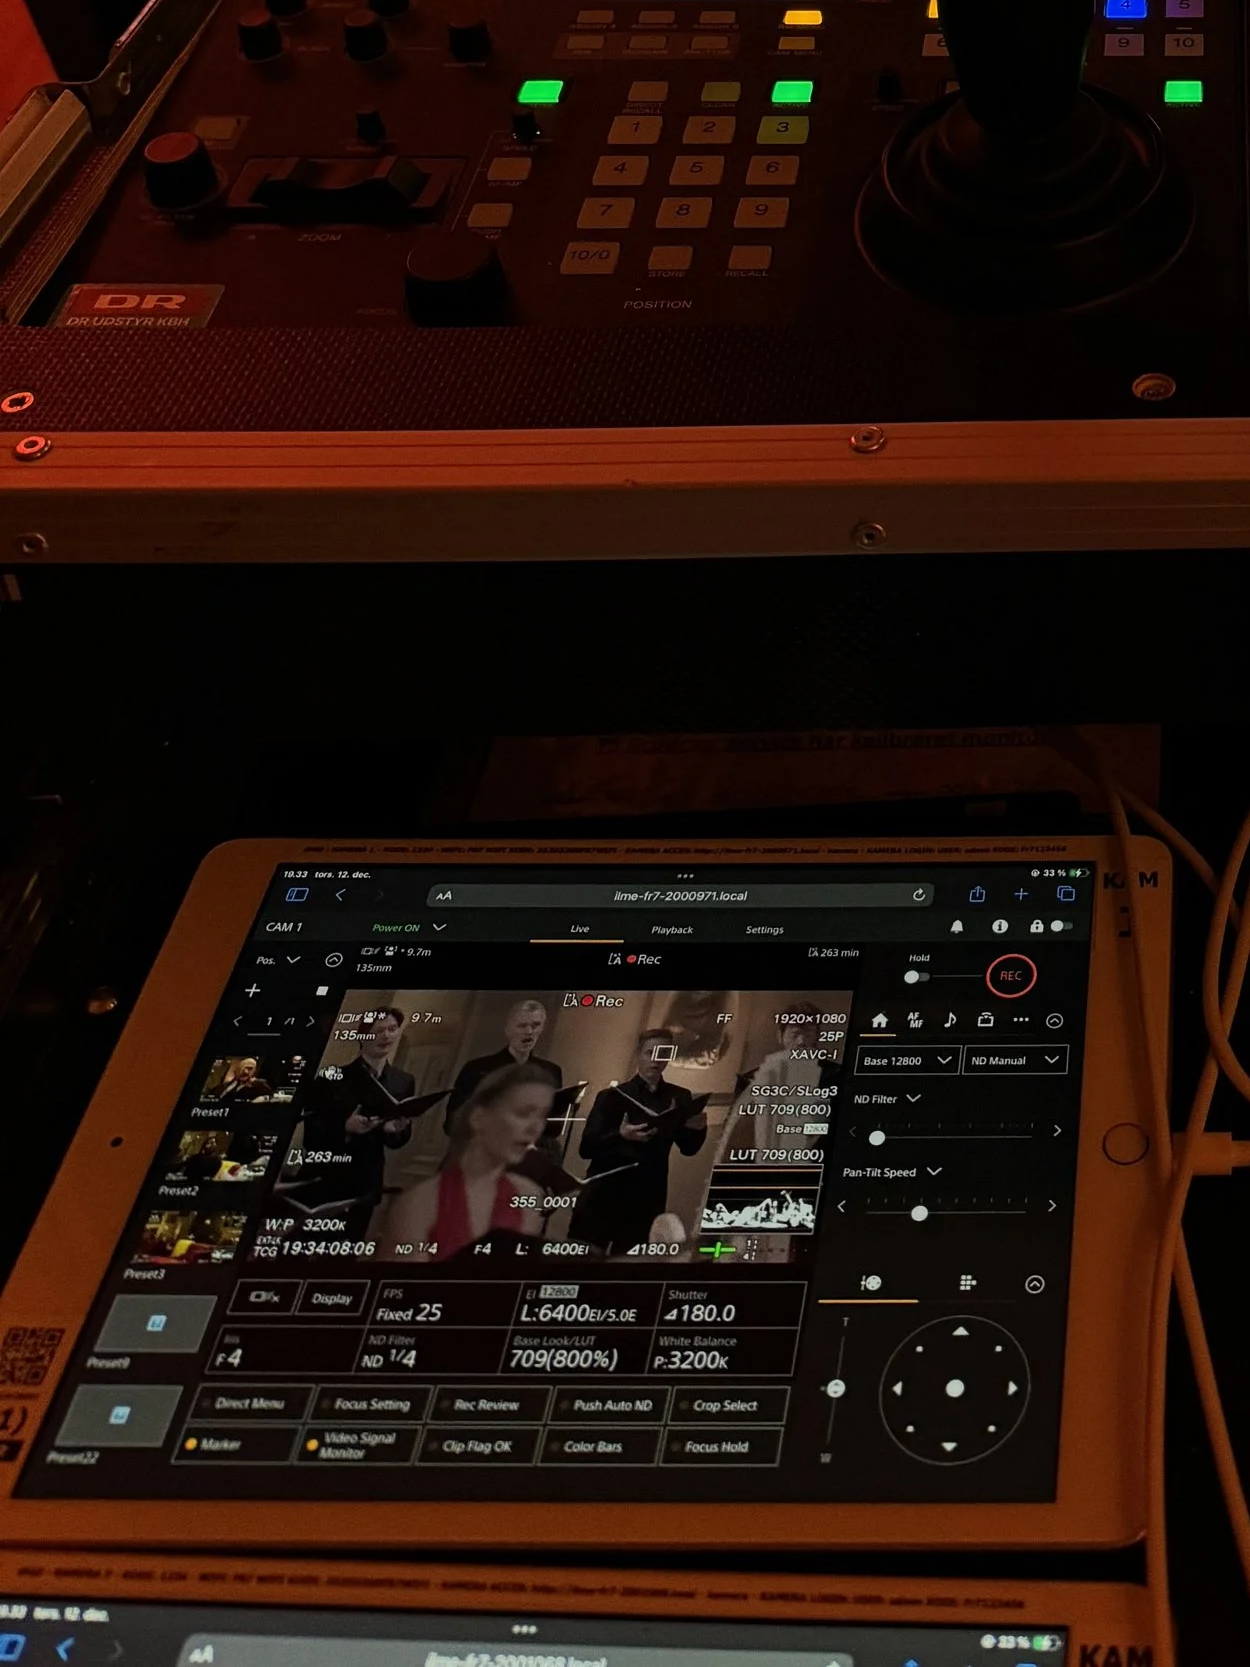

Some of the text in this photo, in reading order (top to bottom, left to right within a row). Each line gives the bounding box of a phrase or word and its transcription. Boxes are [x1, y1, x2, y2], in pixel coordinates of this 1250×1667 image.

[1120, 0, 1131, 8] 4
[1179, 0, 1190, 9] 5
[1118, 38, 1129, 47] 9
[1174, 38, 1194, 47] 10
[631, 122, 641, 133] 1
[702, 121, 716, 133] 2
[776, 122, 789, 133] 3
[612, 162, 628, 172] 4
[689, 162, 705, 172] 5
[765, 162, 780, 172] 6
[600, 204, 613, 216] 7
[676, 204, 691, 216] 8
[754, 204, 768, 216] 9
[569, 250, 611, 260] 10/0
[94, 294, 187, 309] DR
[624, 300, 692, 309] POSITION
[66, 317, 190, 326] DR UDSTYR KBH
[614, 890, 747, 902] ilme-fr7-2000971.local
[266, 922, 293, 932] CAM
[372, 923, 420, 932] Power ON
[637, 954, 662, 965] Rec
[909, 953, 930, 963] Hold
[1000, 970, 1022, 981] REC
[595, 995, 623, 1007] Rec
[818, 1032, 844, 1041] 25P
[789, 1049, 837, 1060] XAVC-I
[864, 1056, 922, 1066] Base 12800
[972, 1056, 1026, 1066] ND Manual
[751, 1086, 838, 1098] SG3C/SLog3
[192, 1107, 229, 1118] Preset1
[739, 1104, 832, 1117] LUT 709(800)
[729, 1149, 824, 1162] LUT 709(800)
[842, 1167, 916, 1179] Pan-Tilt Speed
[510, 1197, 578, 1210] 355_0001
[253, 1242, 375, 1257] TCG 19:34:08:06
[123, 1269, 166, 1281] Preset3
[311, 1293, 353, 1306] Display
[668, 1289, 708, 1300] Shutter
[376, 1303, 443, 1322] Fixed 25
[510, 1349, 618, 1371] 709(800%)
[1080, 1645, 1153, 1667] KAM
